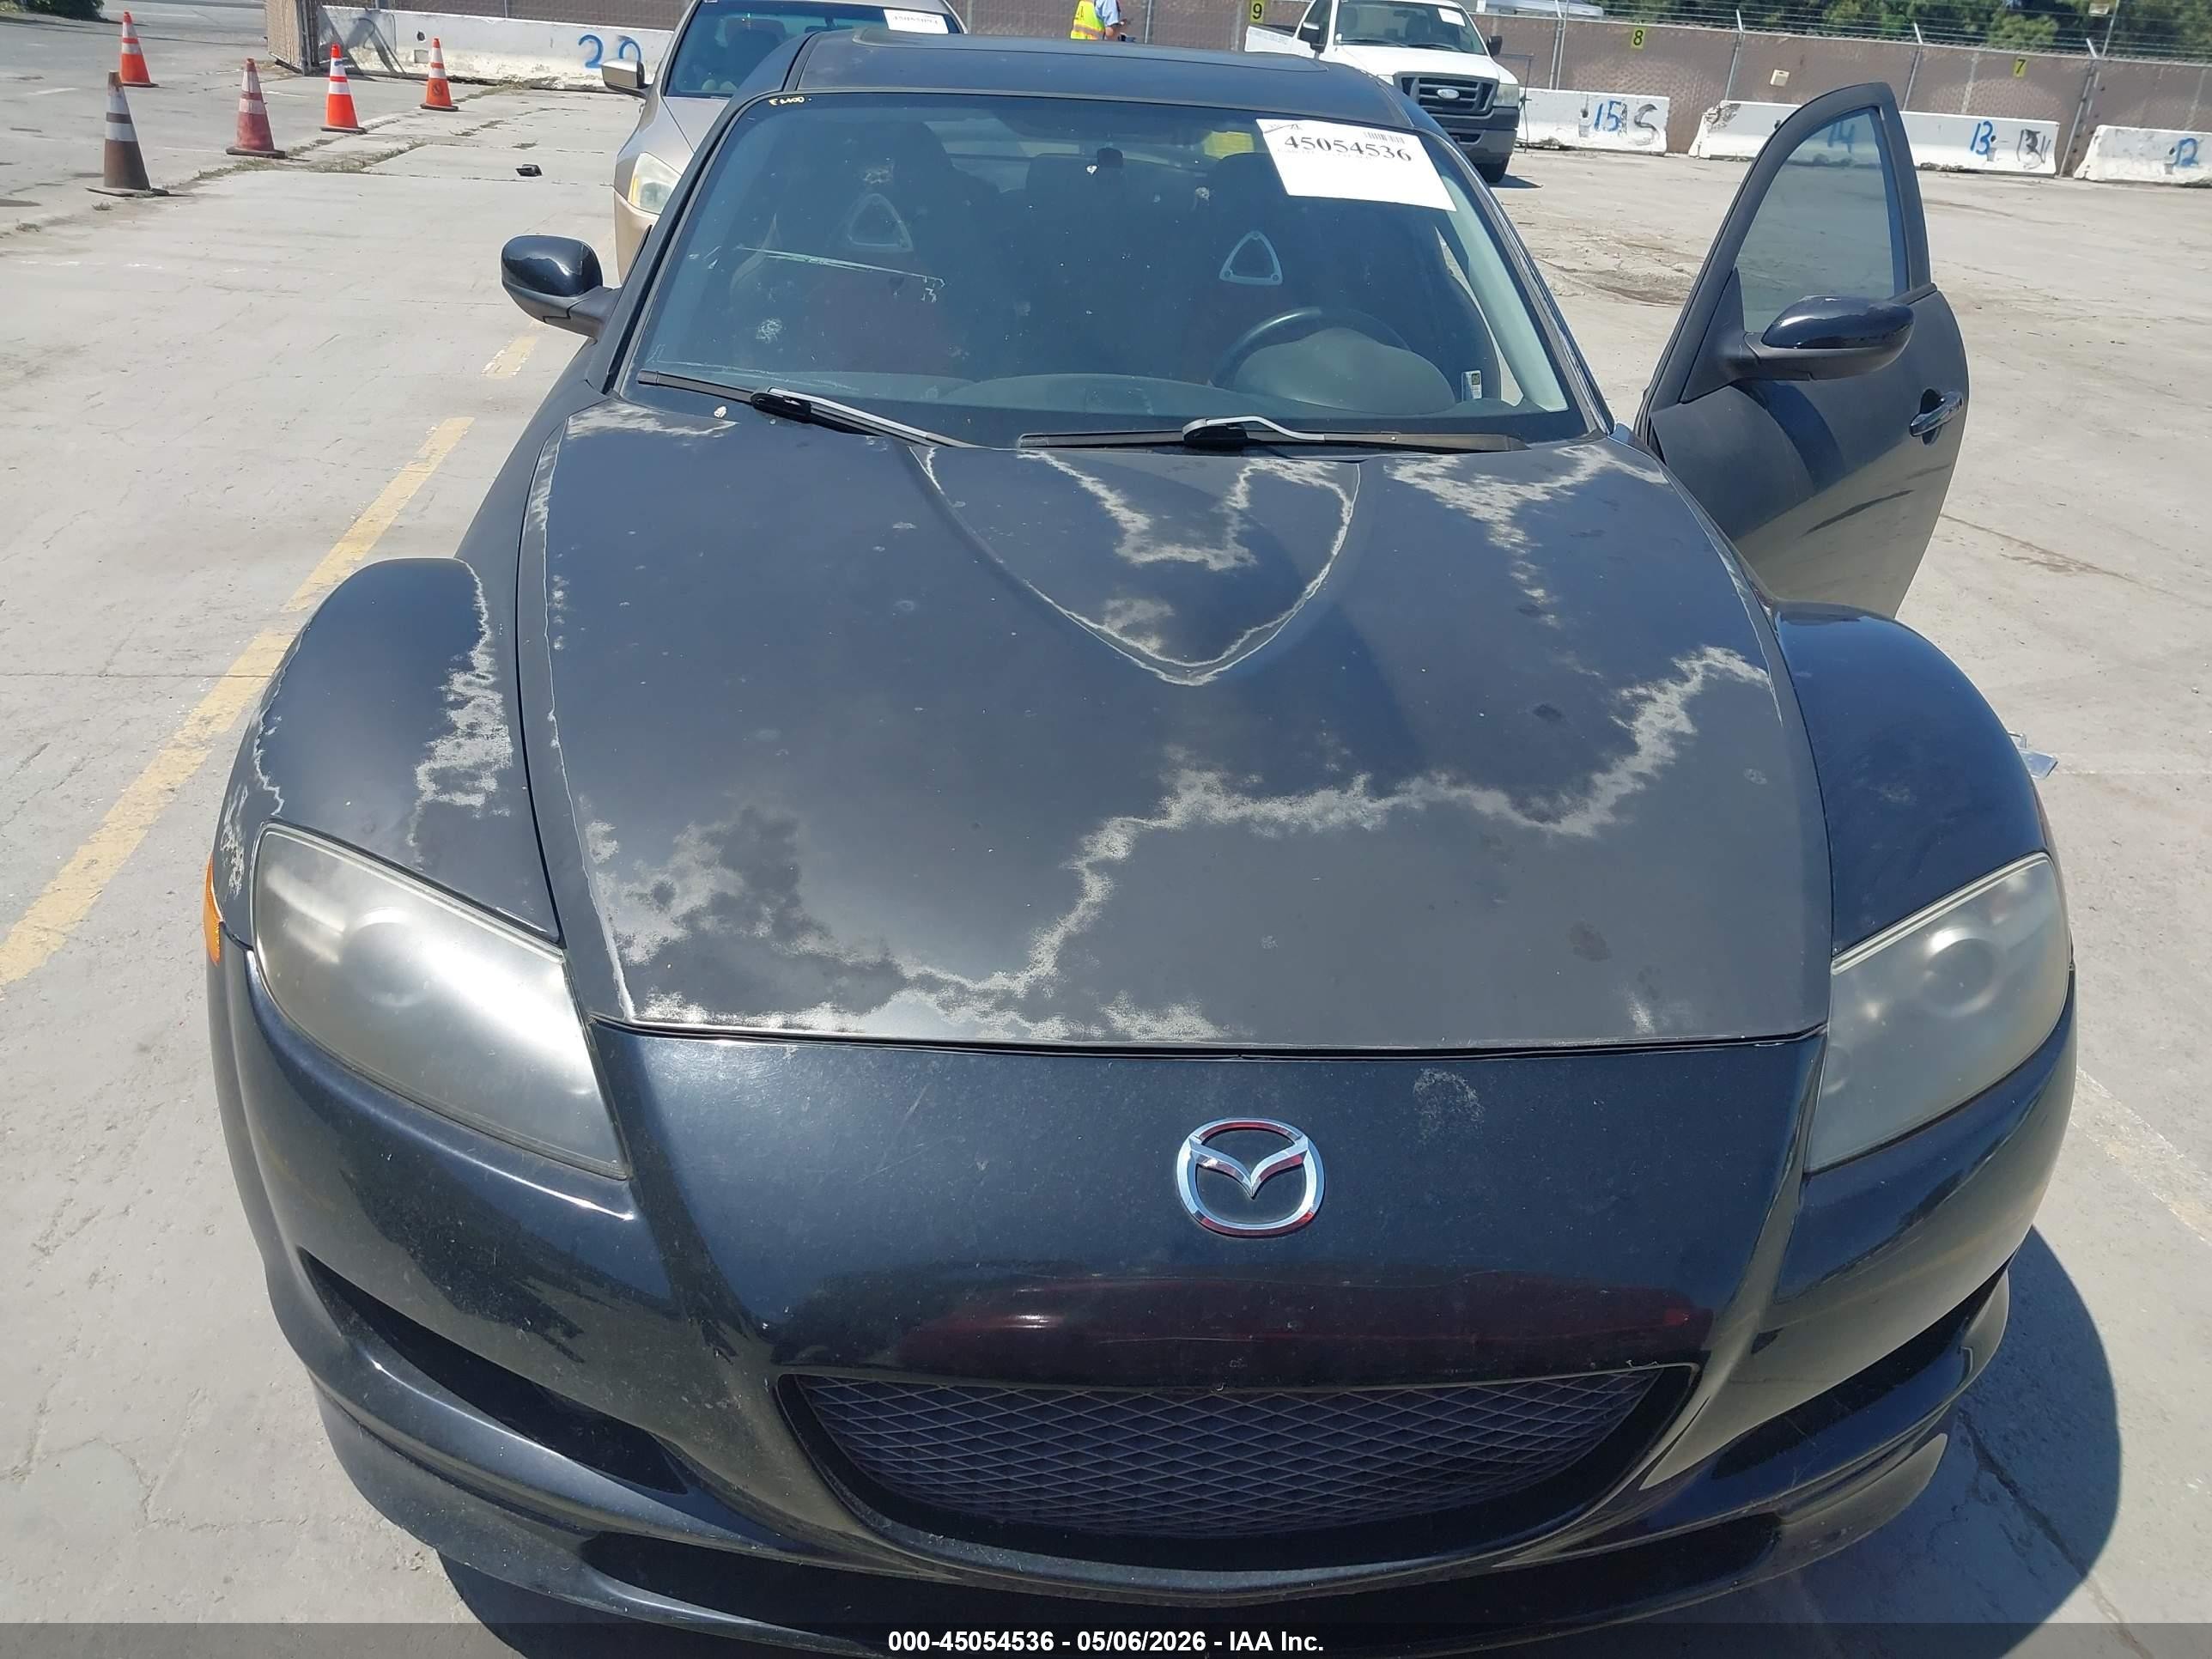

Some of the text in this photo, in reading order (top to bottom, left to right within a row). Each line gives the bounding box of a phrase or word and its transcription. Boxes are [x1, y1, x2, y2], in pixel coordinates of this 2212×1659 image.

[1252, 3, 1262, 20] 9
[1633, 29, 1644, 46] 8
[2016, 58, 2027, 74] 7
[1284, 135, 1413, 162] 45054536
